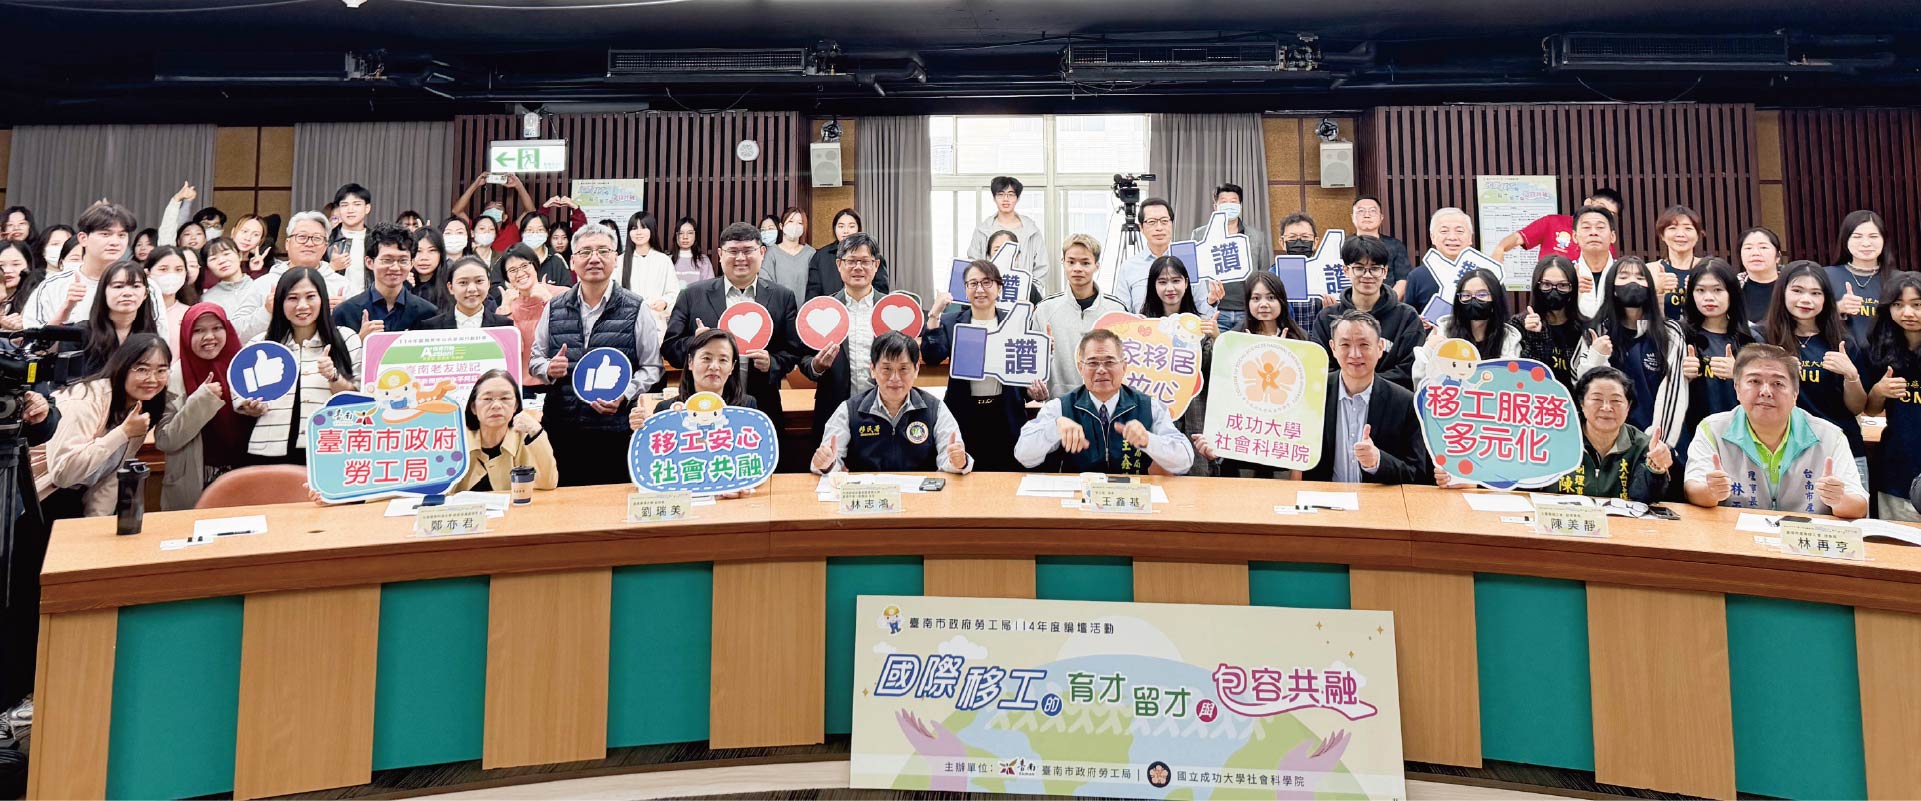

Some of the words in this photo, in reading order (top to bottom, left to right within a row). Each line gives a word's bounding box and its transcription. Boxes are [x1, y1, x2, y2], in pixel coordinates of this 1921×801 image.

[1211, 241, 1241, 275] 讚
[1004, 338, 1038, 375] 讚
[1427, 385, 1569, 428] 移工服務
[316, 427, 457, 453] 臺南市政府
[650, 427, 762, 454] 移工安心
[1226, 412, 1302, 440] 成功大學
[1121, 440, 1132, 474] 王鑫
[1215, 431, 1310, 464] 社會科學院
[1443, 423, 1549, 462] 多元化
[344, 457, 428, 485] 勞工局
[652, 454, 764, 484] 社會共融
[1559, 475, 1575, 493] 陳
[641, 505, 681, 517] 劉瑞美
[1042, 766, 1132, 779] 臺南市政府勞工局
[1177, 771, 1305, 787] 國立成功大學社會科學院
